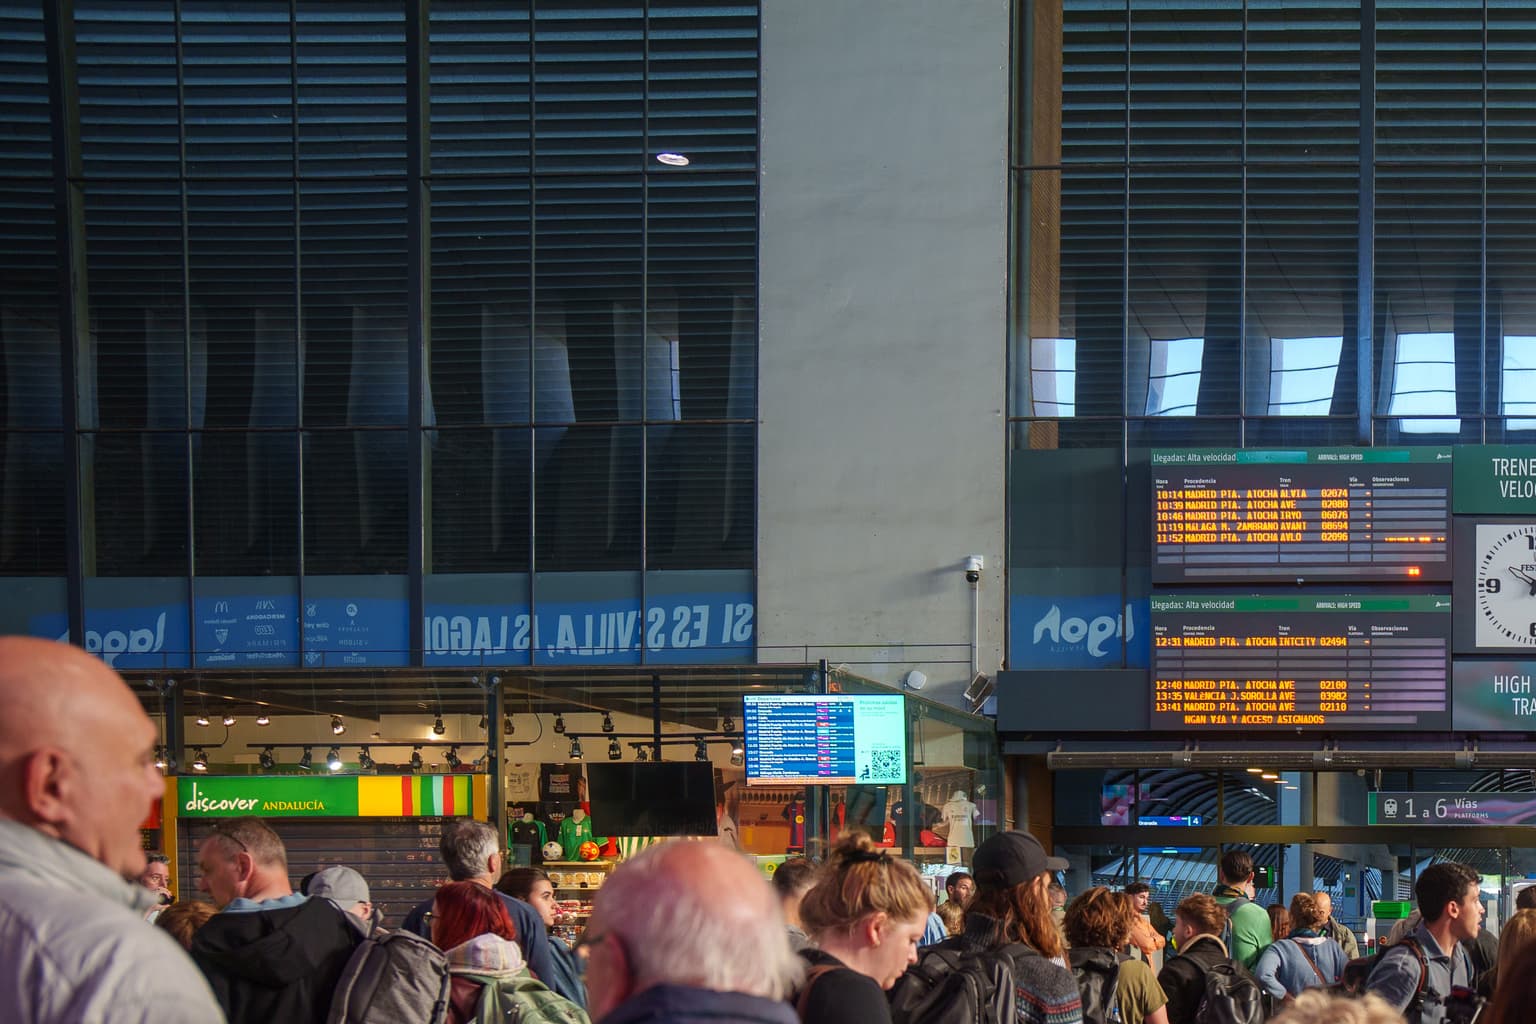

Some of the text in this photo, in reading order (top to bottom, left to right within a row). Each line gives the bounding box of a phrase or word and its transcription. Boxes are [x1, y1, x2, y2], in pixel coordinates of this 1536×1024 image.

[1153, 453, 1236, 463] Llegadas: Alta velocidad
[1185, 490, 1216, 499] MADRID
[1185, 501, 1216, 510] MADRID
[1185, 511, 1216, 521] MADRID
[1185, 533, 1216, 543] MADRID
[1485, 578, 1501, 594] 9
[1151, 600, 1235, 610] Llegadas: Alta velocidad
[1184, 638, 1216, 646] MADRID
[1245, 637, 1277, 646] ATOCHA
[1184, 681, 1216, 690] MADRID
[1245, 681, 1277, 690] ATOCHA
[1493, 676, 1530, 694] HIGH
[1184, 702, 1216, 712] MADRID
[1245, 702, 1277, 712] ATOCHA
[1276, 715, 1325, 724] ASIGNADOS
[185, 782, 325, 812] discover ANDALUCÍA
[1405, 797, 1478, 818] 1 a 6 Vías
[1193, 817, 1199, 825] 4
